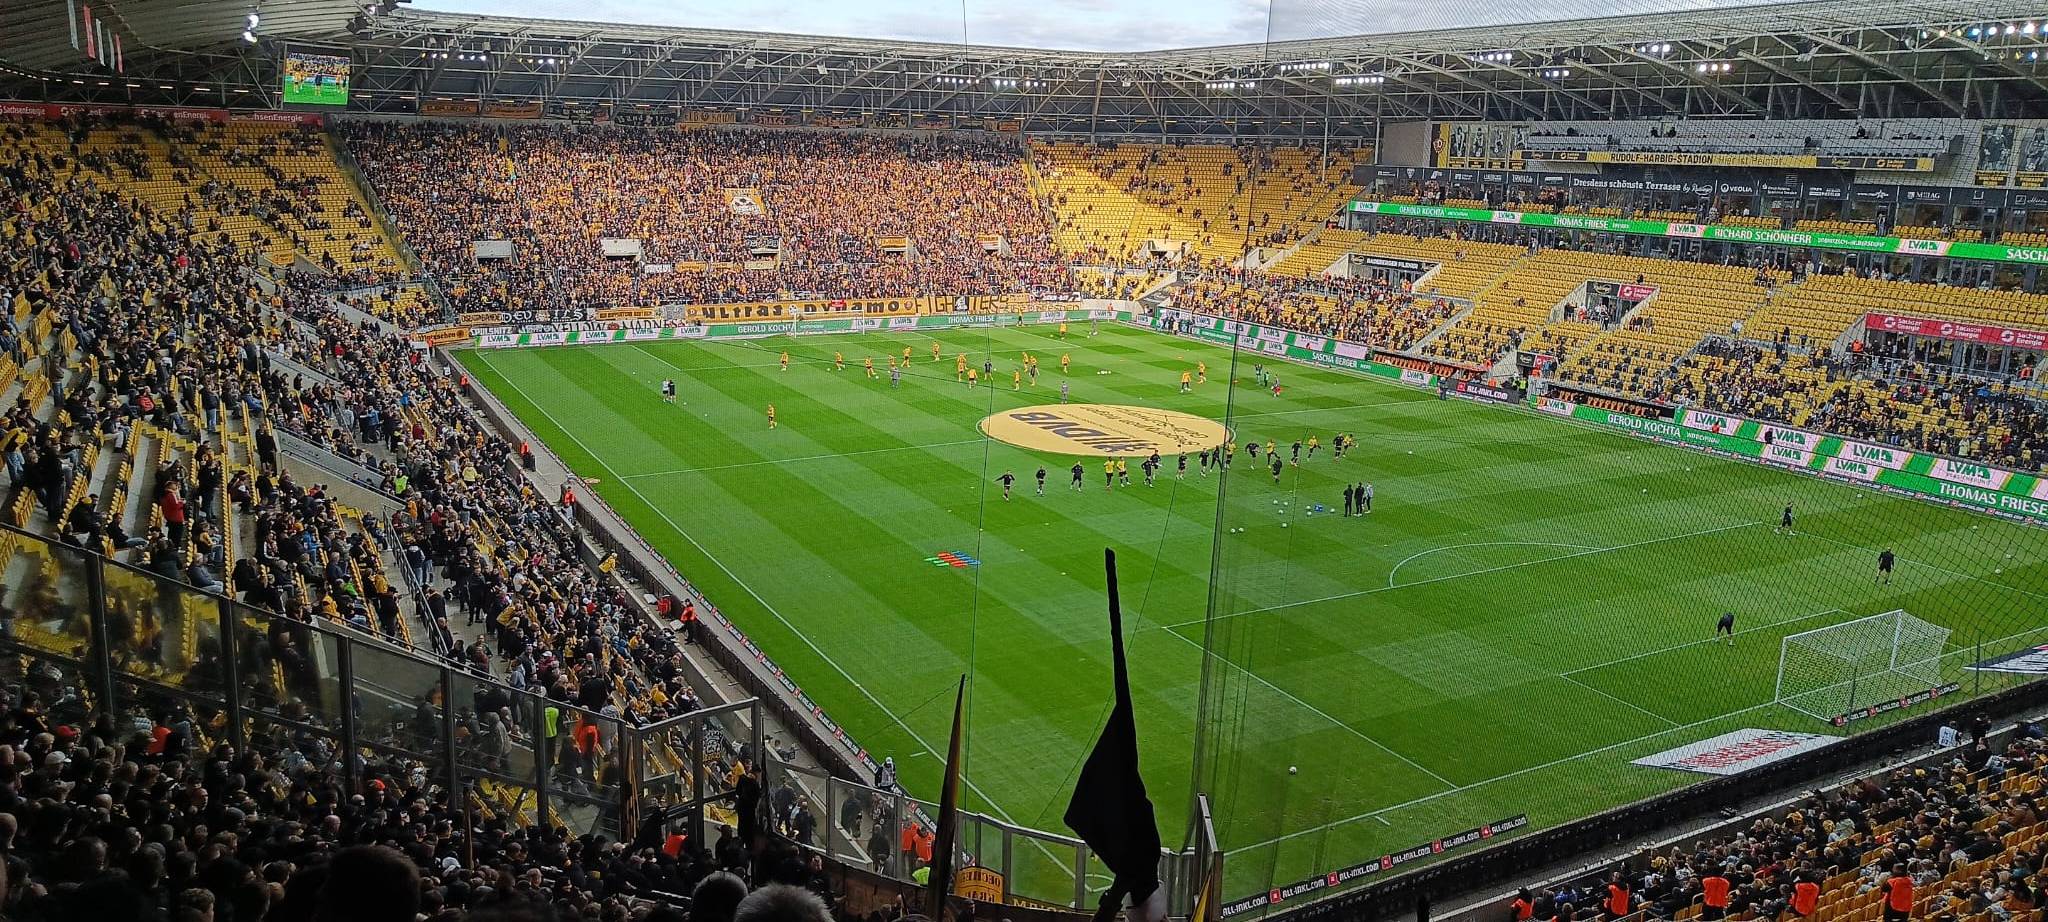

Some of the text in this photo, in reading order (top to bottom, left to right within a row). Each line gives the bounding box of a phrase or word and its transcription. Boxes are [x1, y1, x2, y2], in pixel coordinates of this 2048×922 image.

[1611, 153, 1713, 164] RUDOLF-HARBIG-STADION
[1573, 178, 1608, 188] Dresdens
[1609, 179, 1643, 189] schönste
[1645, 181, 1681, 191] Terrasse
[1729, 185, 1753, 193] VEOLIA
[1552, 217, 1583, 227] THOMAS
[1584, 218, 1609, 228] FRIESE
[1714, 228, 1753, 239] RICHARD
[1755, 230, 1812, 244] SCHÖNHERR
[1908, 241, 1929, 249] LVM
[948, 316, 974, 324] THOMAS
[1897, 318, 1922, 326] Sachsen
[738, 325, 766, 334] GEROLD
[1897, 323, 1921, 332] Energie
[1955, 325, 1982, 333] Sachsen
[1954, 331, 1979, 339] Energie
[2017, 332, 2046, 341] Sachsen
[2016, 338, 2043, 346] Energie
[1312, 351, 1335, 363] SASCHA
[1466, 385, 1508, 400] ALL-INKL.COM
[1607, 413, 1642, 429] GEROLD
[1644, 420, 1681, 438] KOCHTA
[1772, 446, 1793, 459] LVM
[1853, 444, 1881, 460] LVM
[1836, 460, 1858, 473] LVM
[1946, 460, 1977, 476] LVM
[1939, 482, 2048, 516] THOMAS FRIESE
[1491, 816, 1527, 834] ALL-INKL.COM
[1442, 831, 1480, 849] ALL-INKL.COM
[1392, 846, 1431, 865] ALL-INKL.COM
[1339, 862, 1379, 881] ALL-INKL.COM
[1282, 878, 1325, 898] ALL-INKL.COM
[1222, 895, 1267, 917] ALL-INKL.COM
